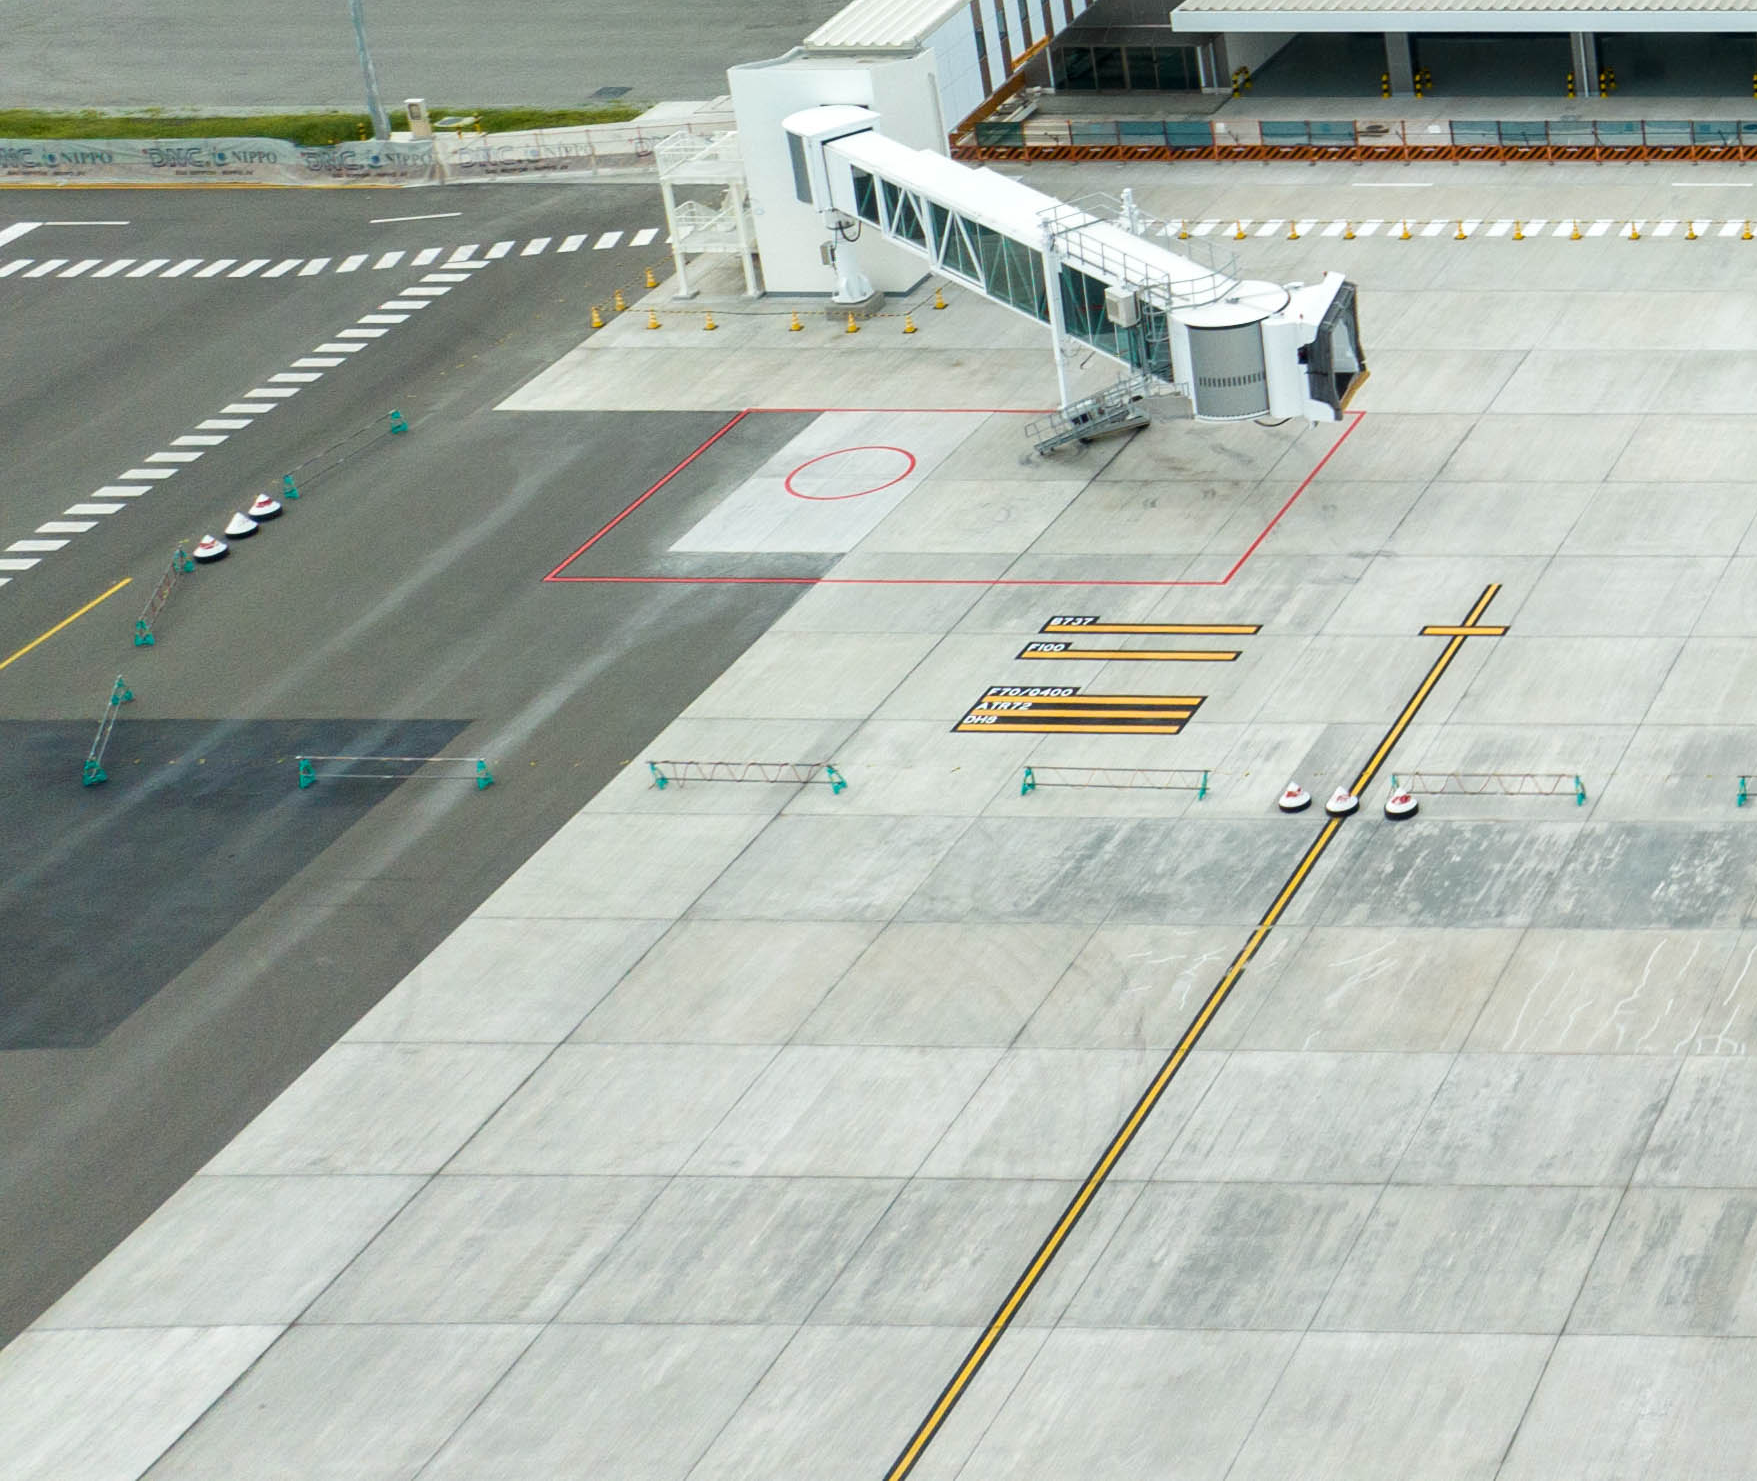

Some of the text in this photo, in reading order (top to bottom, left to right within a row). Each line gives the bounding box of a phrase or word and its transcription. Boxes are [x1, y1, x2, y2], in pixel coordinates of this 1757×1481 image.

[60, 151, 112, 165] NIPPO
[231, 151, 278, 164] NIPPO
[1050, 617, 1094, 626] B737
[1028, 643, 1066, 652] F100
[975, 702, 1033, 711] ATR72
